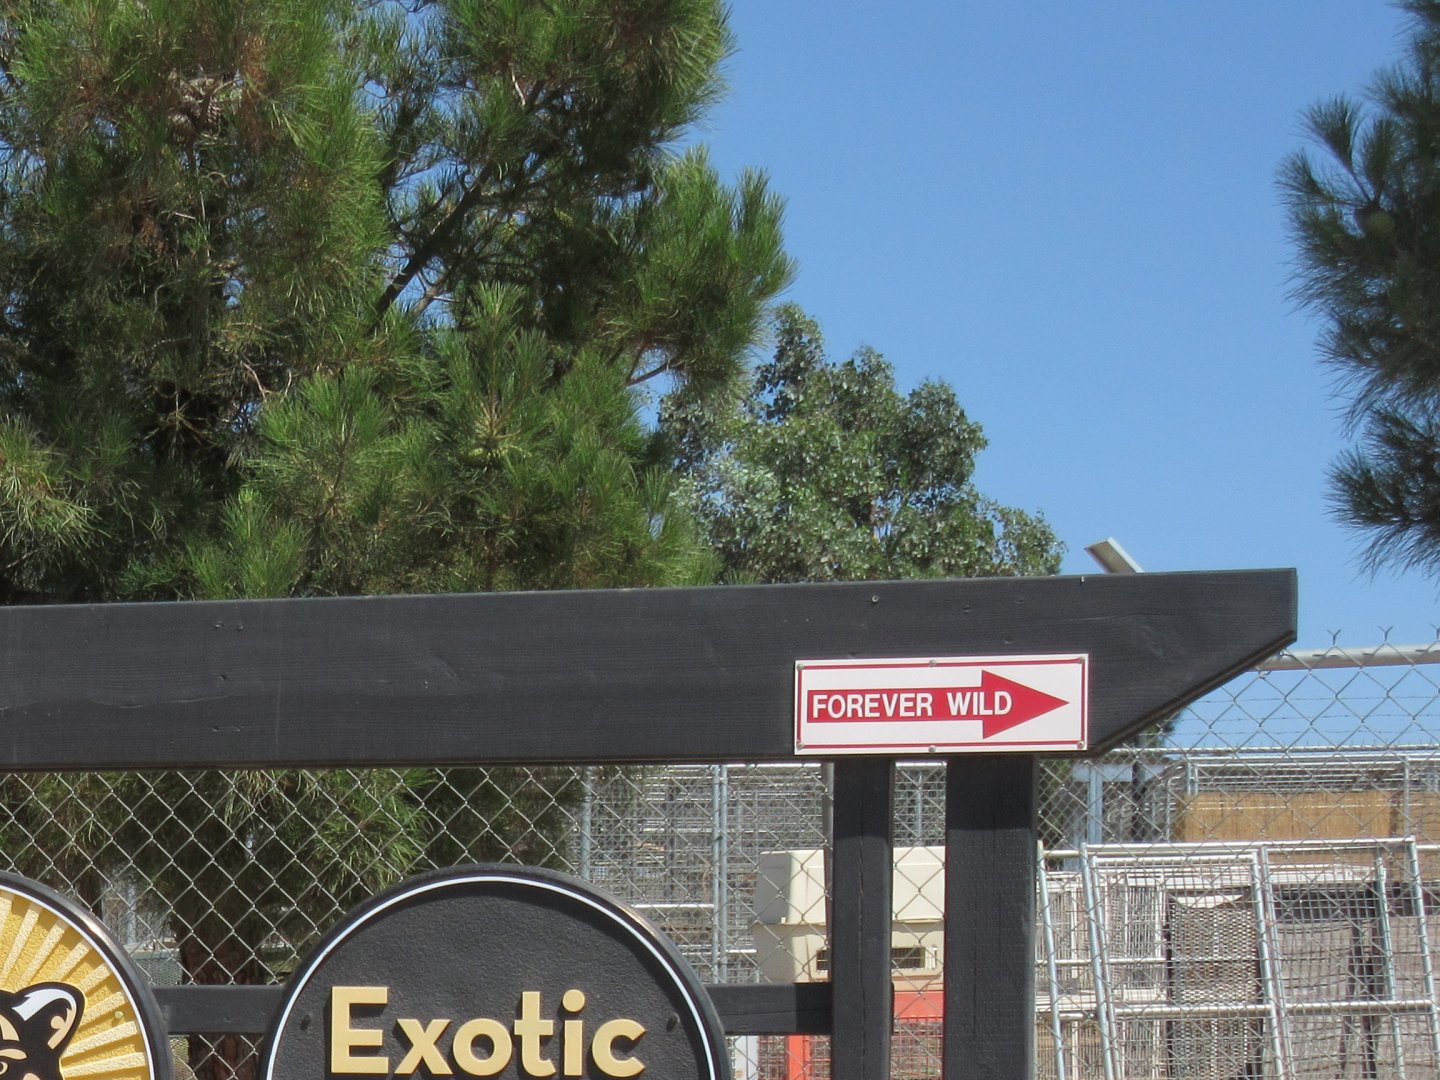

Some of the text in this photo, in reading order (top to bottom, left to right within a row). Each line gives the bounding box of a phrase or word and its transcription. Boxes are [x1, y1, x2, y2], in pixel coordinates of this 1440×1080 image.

[812, 690, 1013, 719] FOREVER WILD
[330, 986, 646, 1077] Exotic
